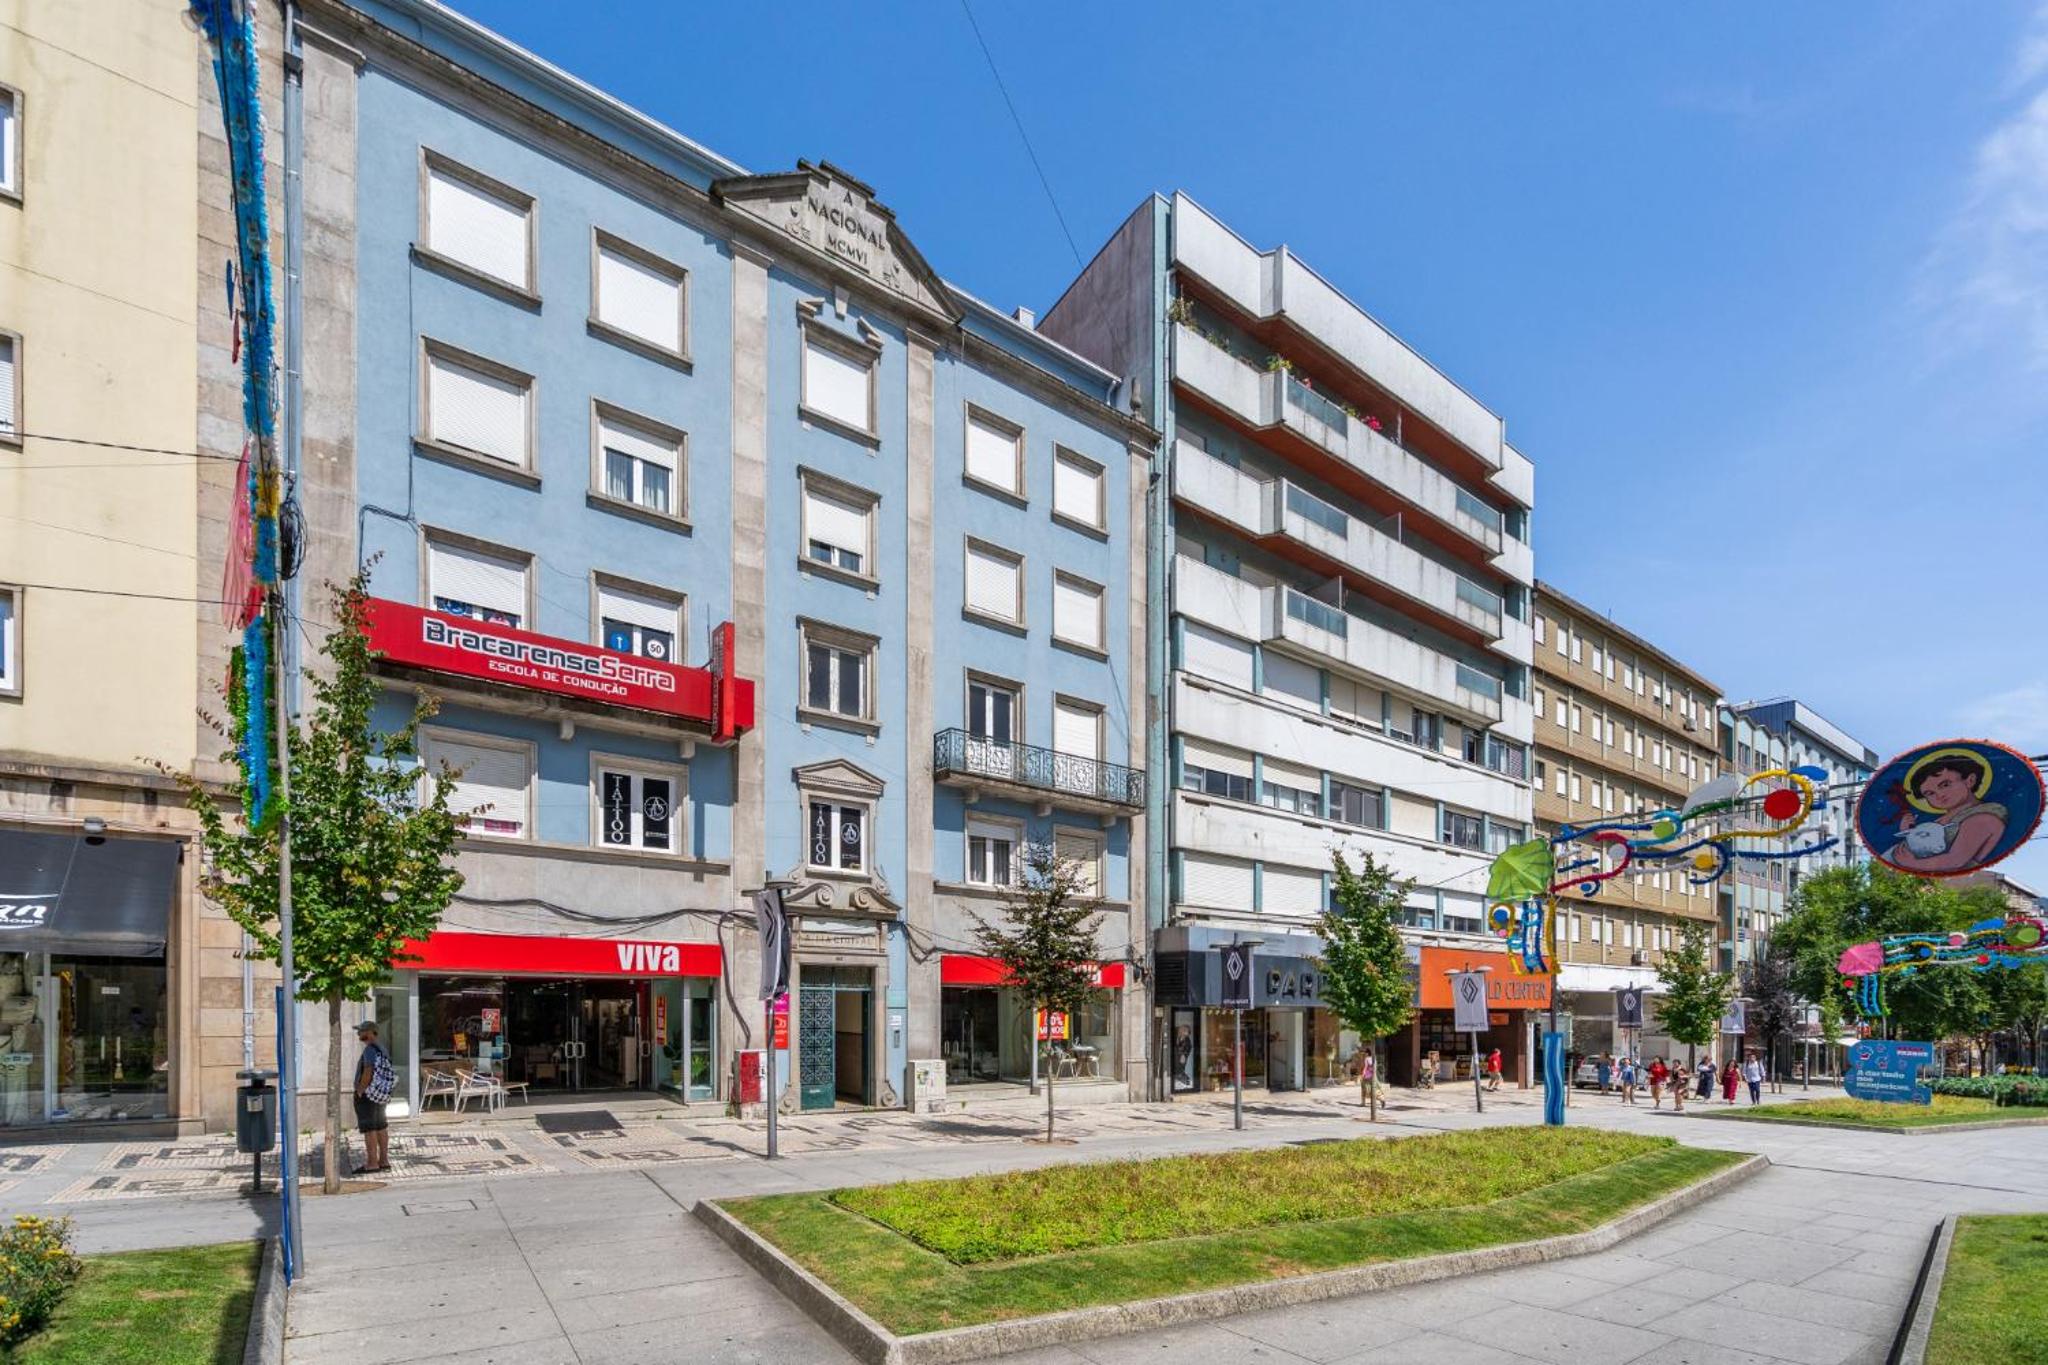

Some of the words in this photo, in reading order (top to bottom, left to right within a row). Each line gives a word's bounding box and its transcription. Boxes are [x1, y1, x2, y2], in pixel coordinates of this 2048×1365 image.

[843, 189, 853, 206] A
[808, 195, 886, 251] NACIONAL
[827, 234, 868, 265] MCMVI
[650, 643, 662, 654] 50
[488, 660, 538, 680] ESCOLA
[543, 671, 559, 682] DE
[563, 673, 628, 696] CONDUÇÃO
[611, 775, 624, 843] TATTOO
[815, 805, 826, 864] TATTOO
